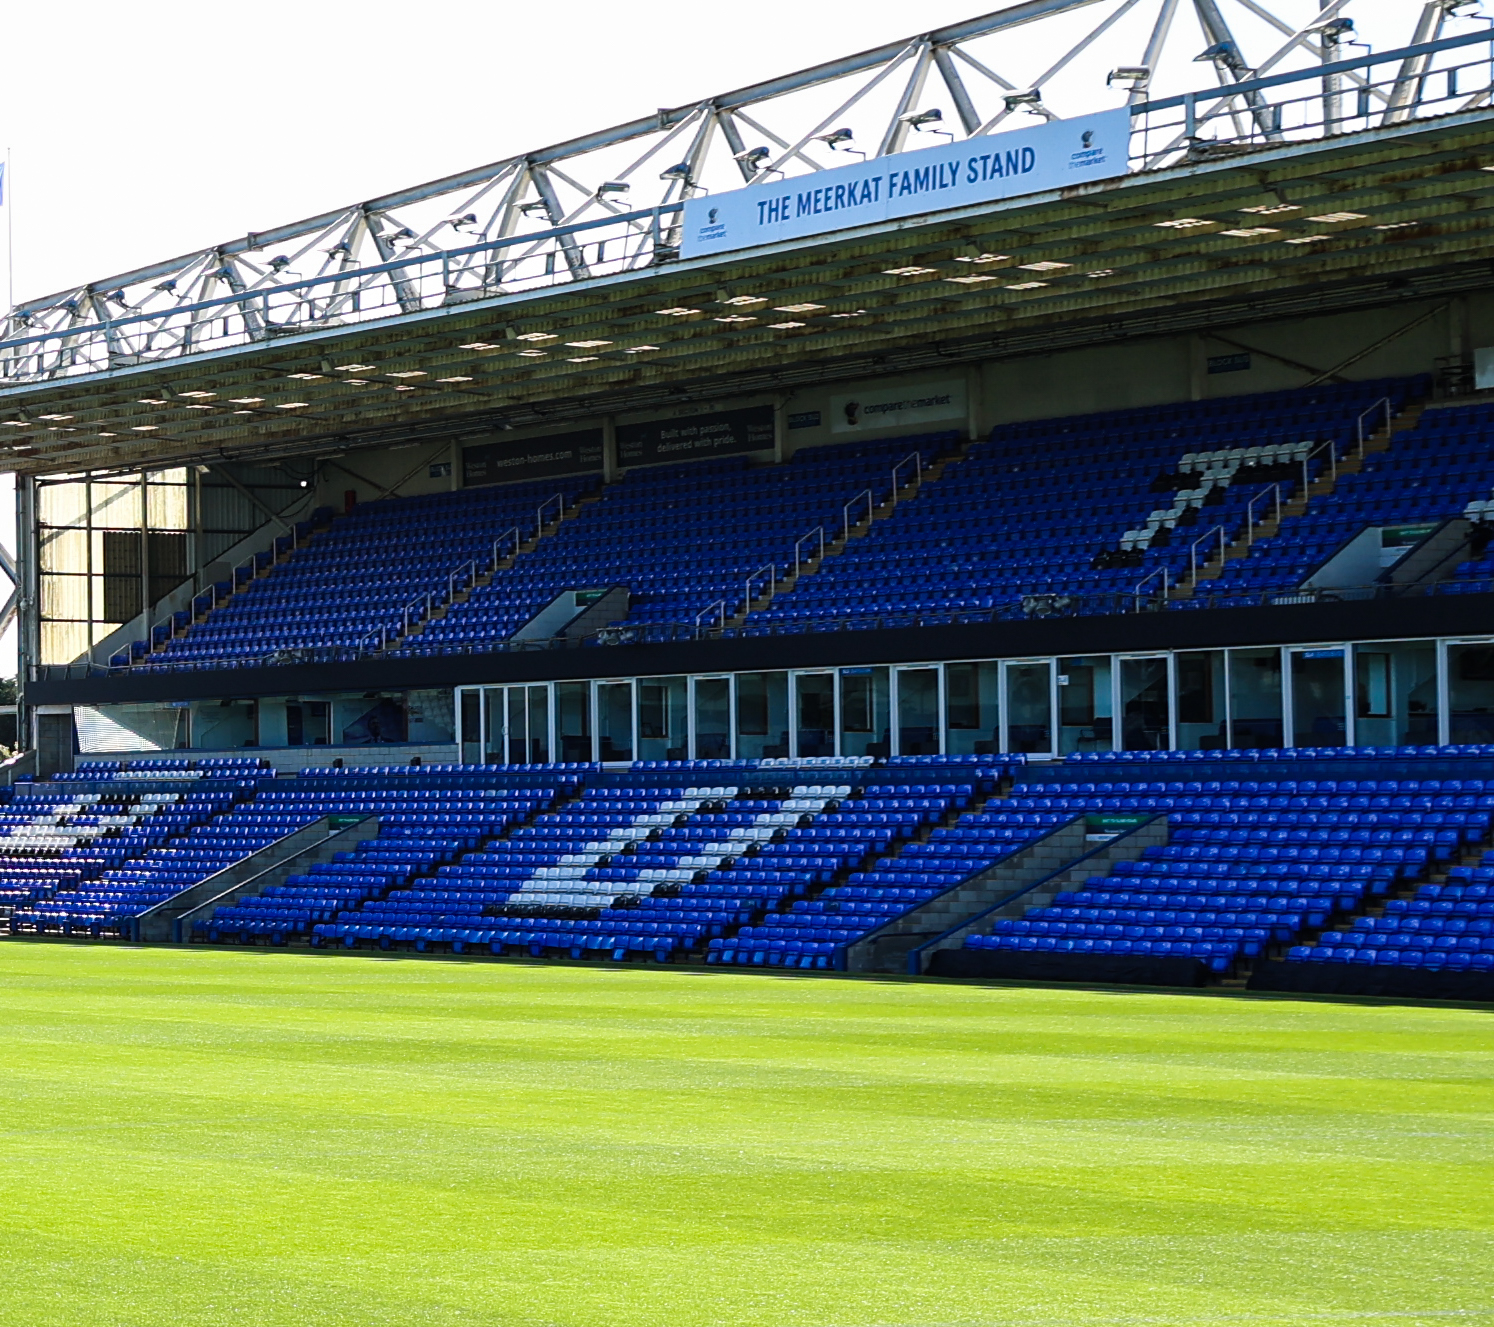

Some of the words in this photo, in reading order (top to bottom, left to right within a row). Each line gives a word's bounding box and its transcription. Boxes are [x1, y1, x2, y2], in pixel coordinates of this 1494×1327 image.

[757, 195, 791, 226] THE
[796, 175, 883, 218] MEERKAT
[888, 159, 961, 199] FAMILY
[966, 146, 1036, 184] STAND
[496, 450, 573, 468] weston-homes.com
